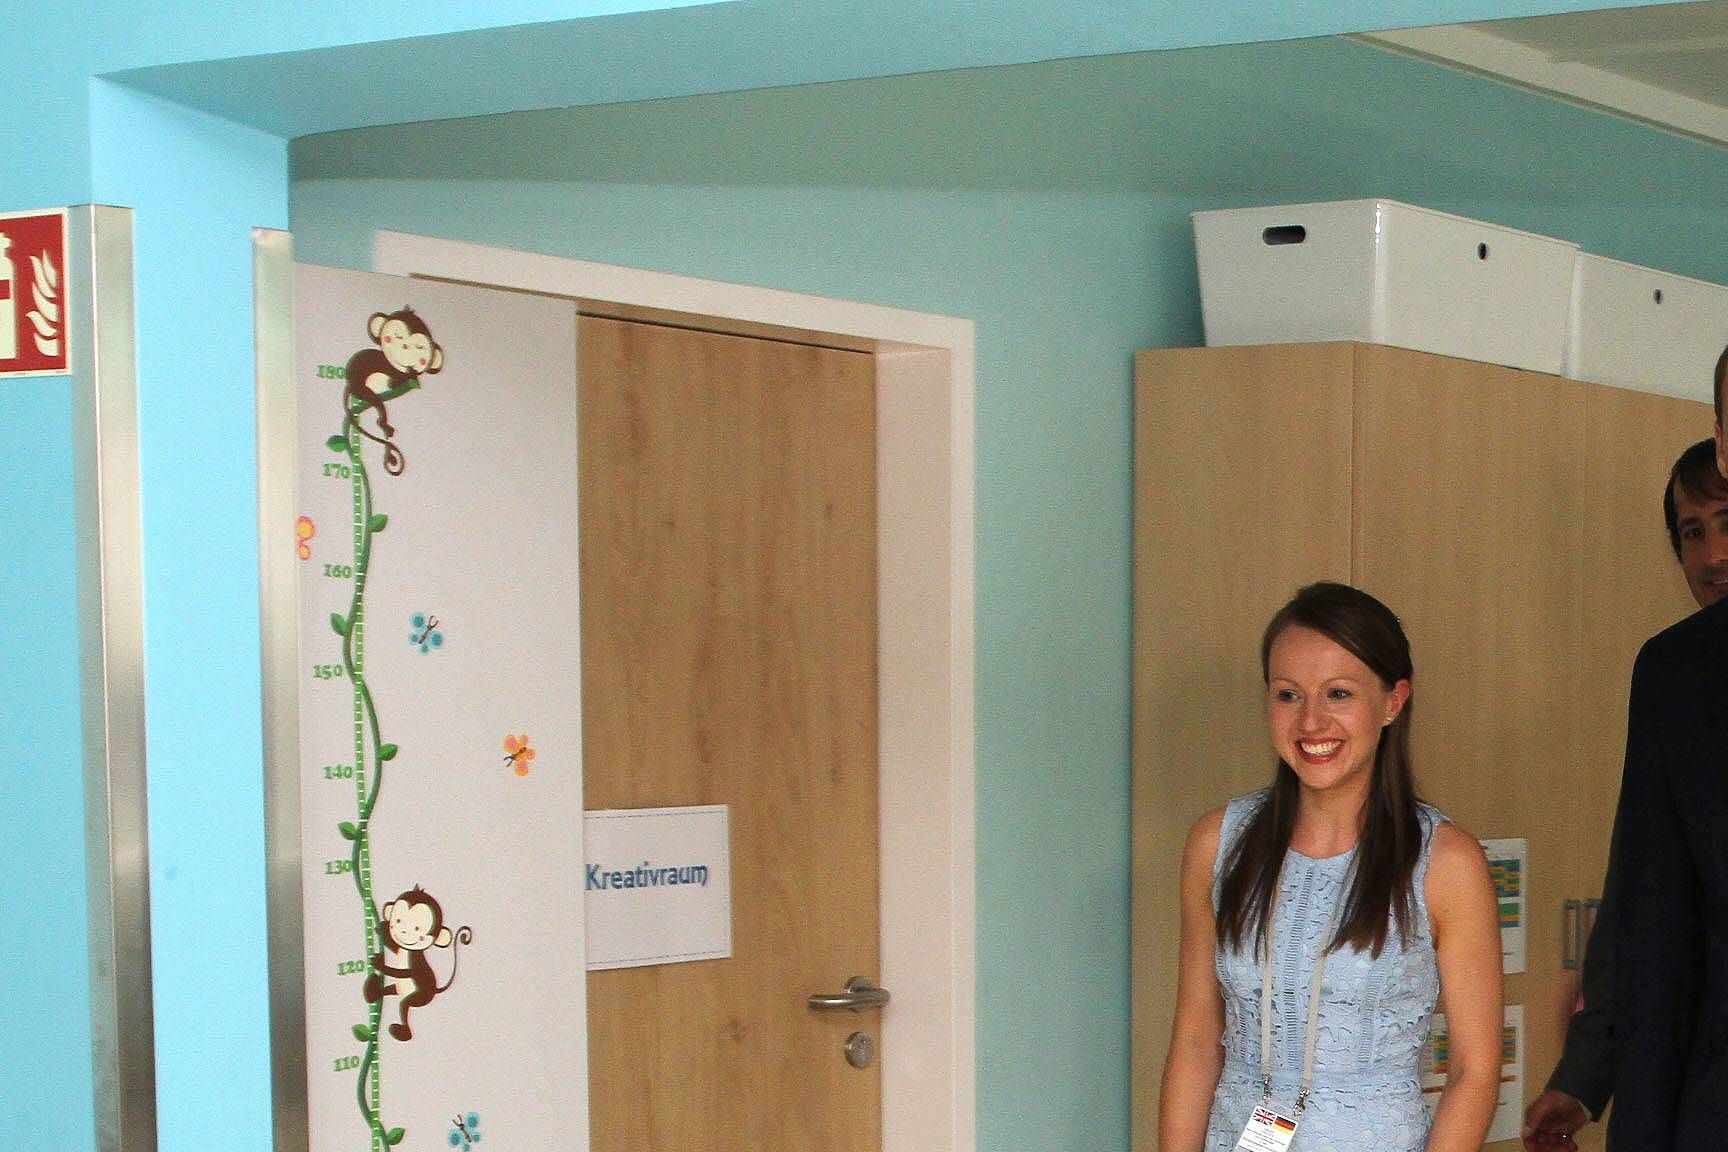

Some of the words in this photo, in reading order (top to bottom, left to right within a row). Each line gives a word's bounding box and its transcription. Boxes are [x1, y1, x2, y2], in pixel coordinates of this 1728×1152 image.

[317, 365, 347, 379] 180
[323, 463, 352, 478] 170
[324, 564, 352, 578] 160
[314, 665, 342, 679] 150
[324, 765, 353, 779] 140
[325, 861, 354, 874] 130
[584, 861, 708, 890] Kreativraum
[336, 960, 365, 975] 120
[333, 1056, 360, 1071] 110
